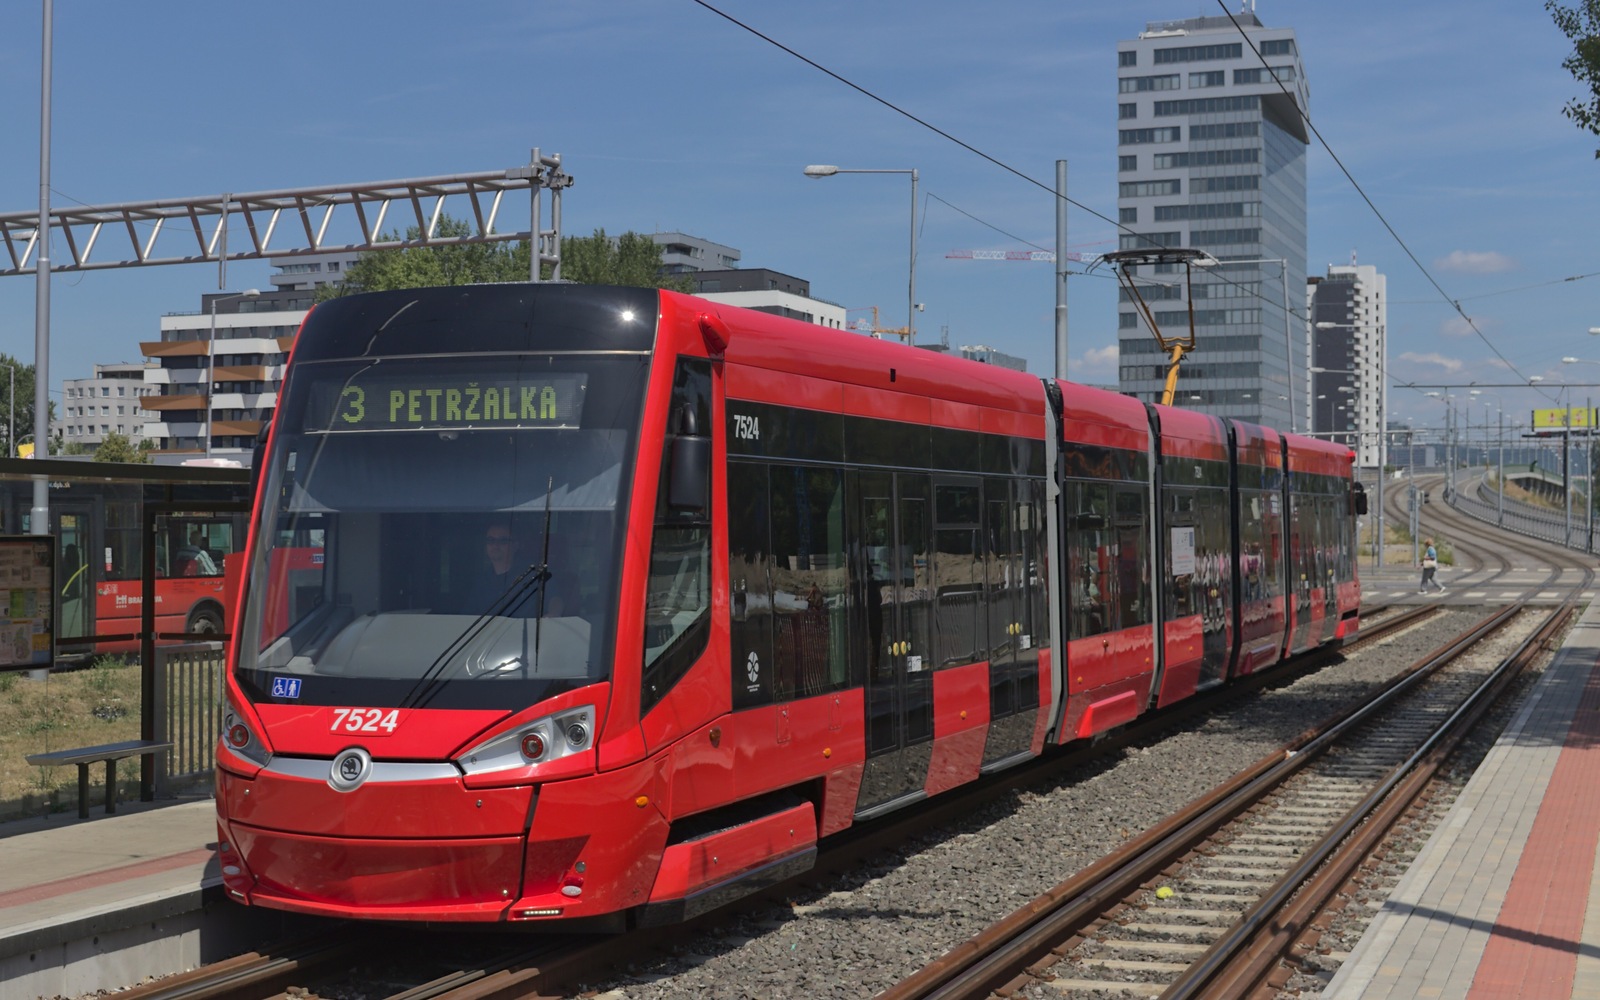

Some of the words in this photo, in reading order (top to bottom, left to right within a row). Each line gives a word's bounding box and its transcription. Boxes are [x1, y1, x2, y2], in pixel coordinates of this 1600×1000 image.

[342, 385, 365, 423] 3
[390, 382, 556, 422] PETRŽALKA
[734, 414, 760, 440] 7524
[331, 708, 400, 733] 7524
